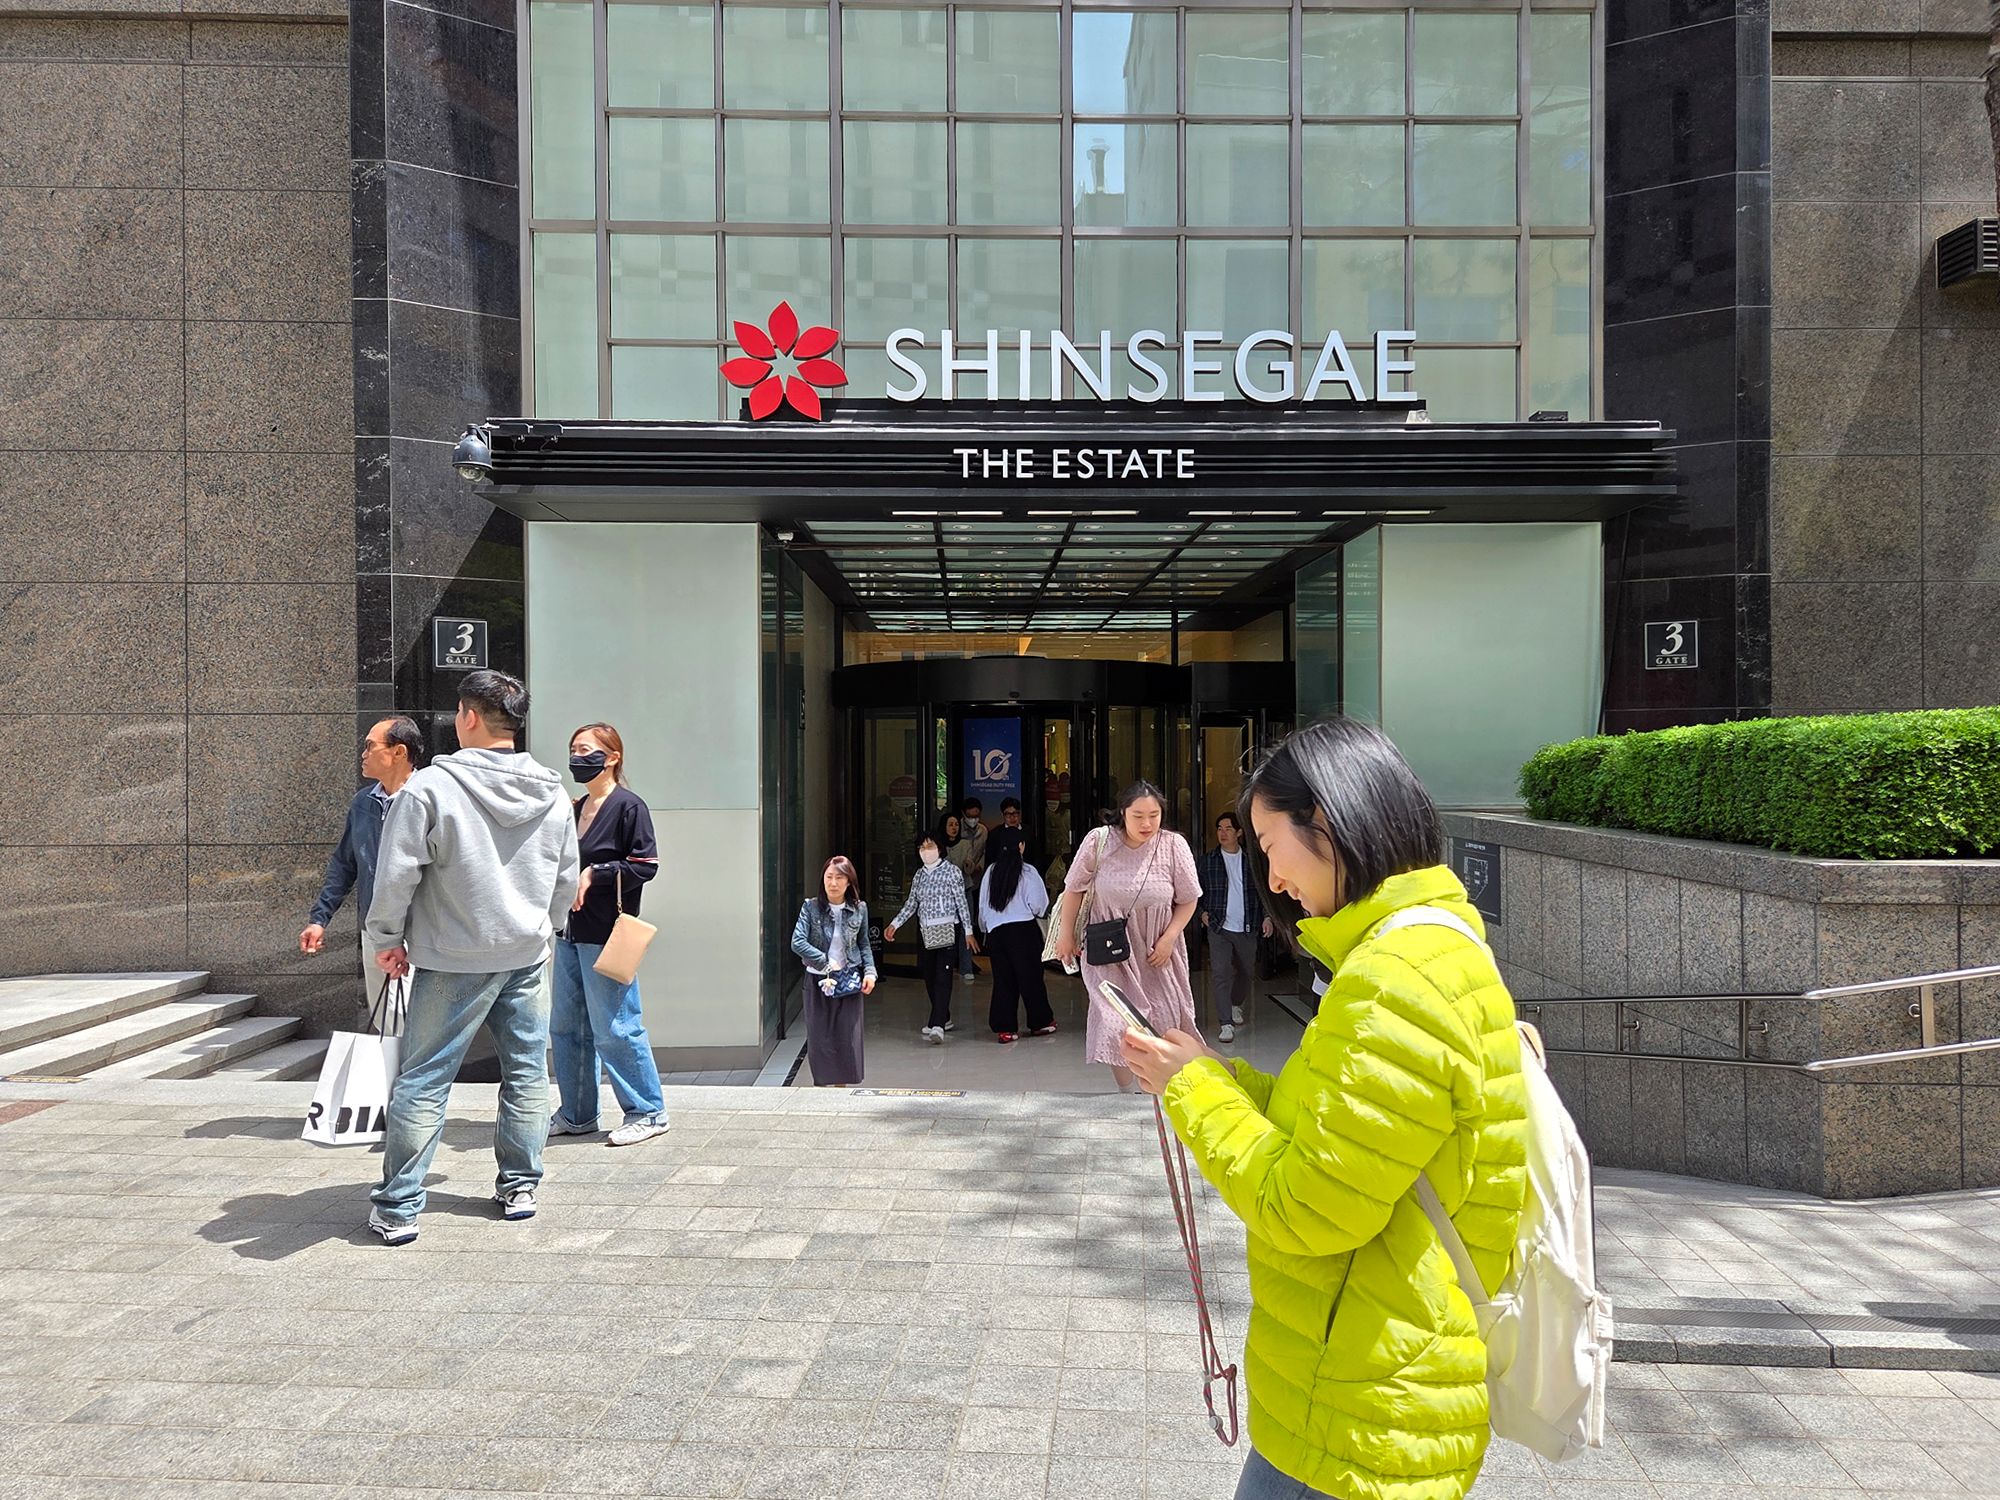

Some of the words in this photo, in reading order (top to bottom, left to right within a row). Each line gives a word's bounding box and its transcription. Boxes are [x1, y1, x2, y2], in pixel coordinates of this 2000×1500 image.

[885, 328, 1418, 403] SHINSEGAE
[953, 448, 1034, 479] THE
[1052, 448, 1196, 479] ESTATE
[449, 623, 474, 653] 3
[1660, 623, 1683, 654] 3
[446, 656, 477, 664] GATE
[1655, 656, 1687, 664] GATE
